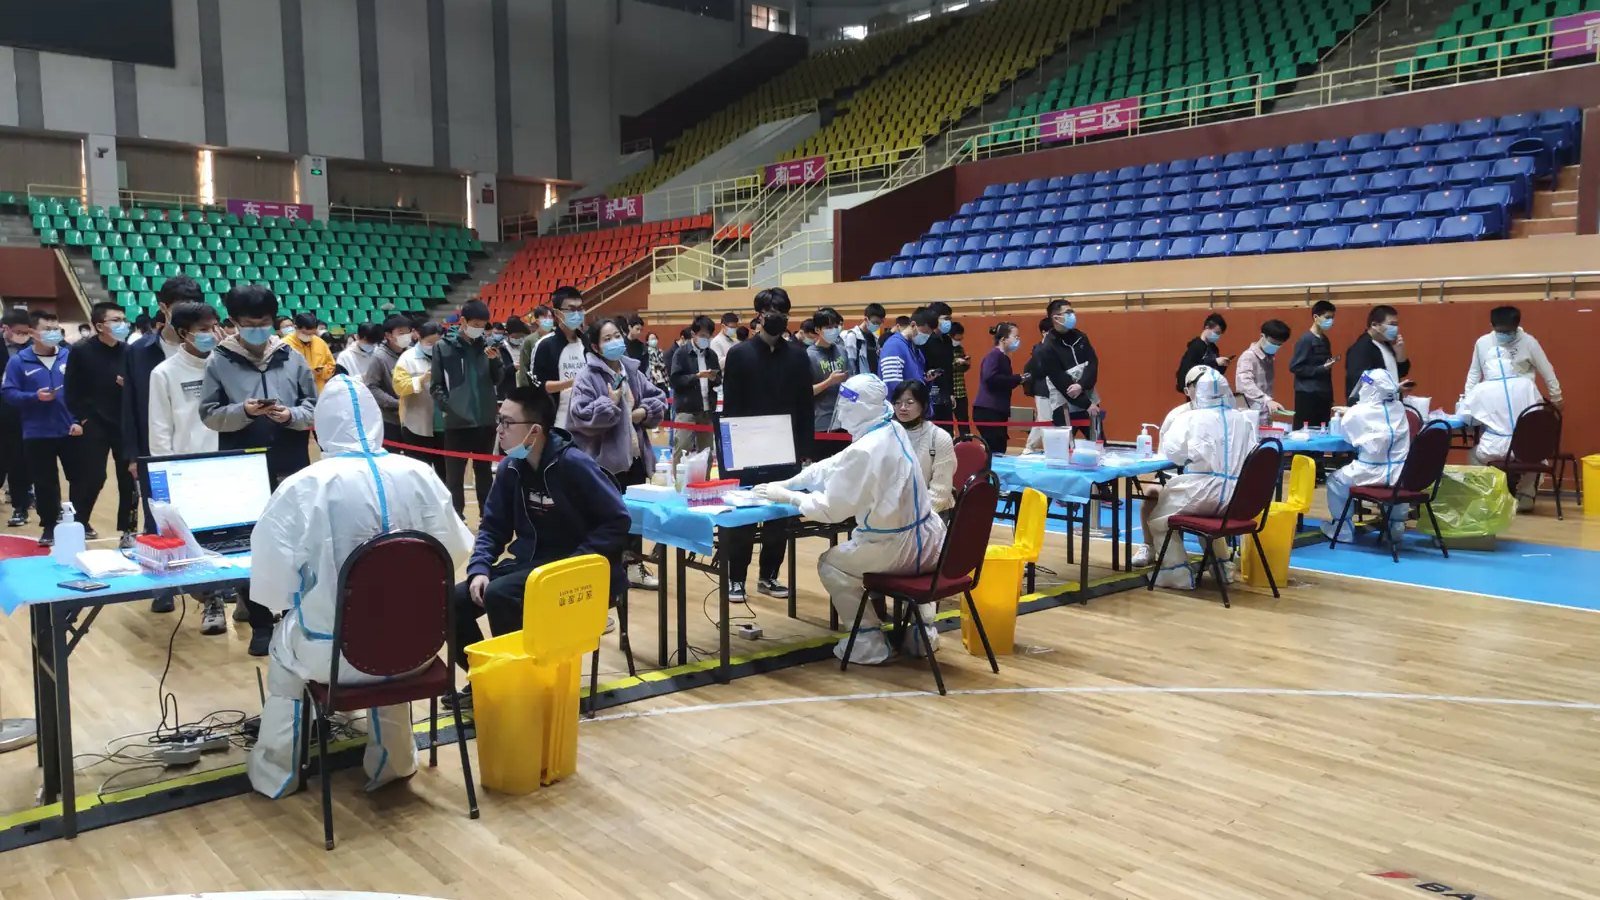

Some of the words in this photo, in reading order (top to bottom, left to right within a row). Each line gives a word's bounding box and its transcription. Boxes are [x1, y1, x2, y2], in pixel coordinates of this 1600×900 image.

[1055, 103, 1121, 138] 南三区
[774, 160, 816, 186] 南二区
[242, 202, 300, 221] 东二区
